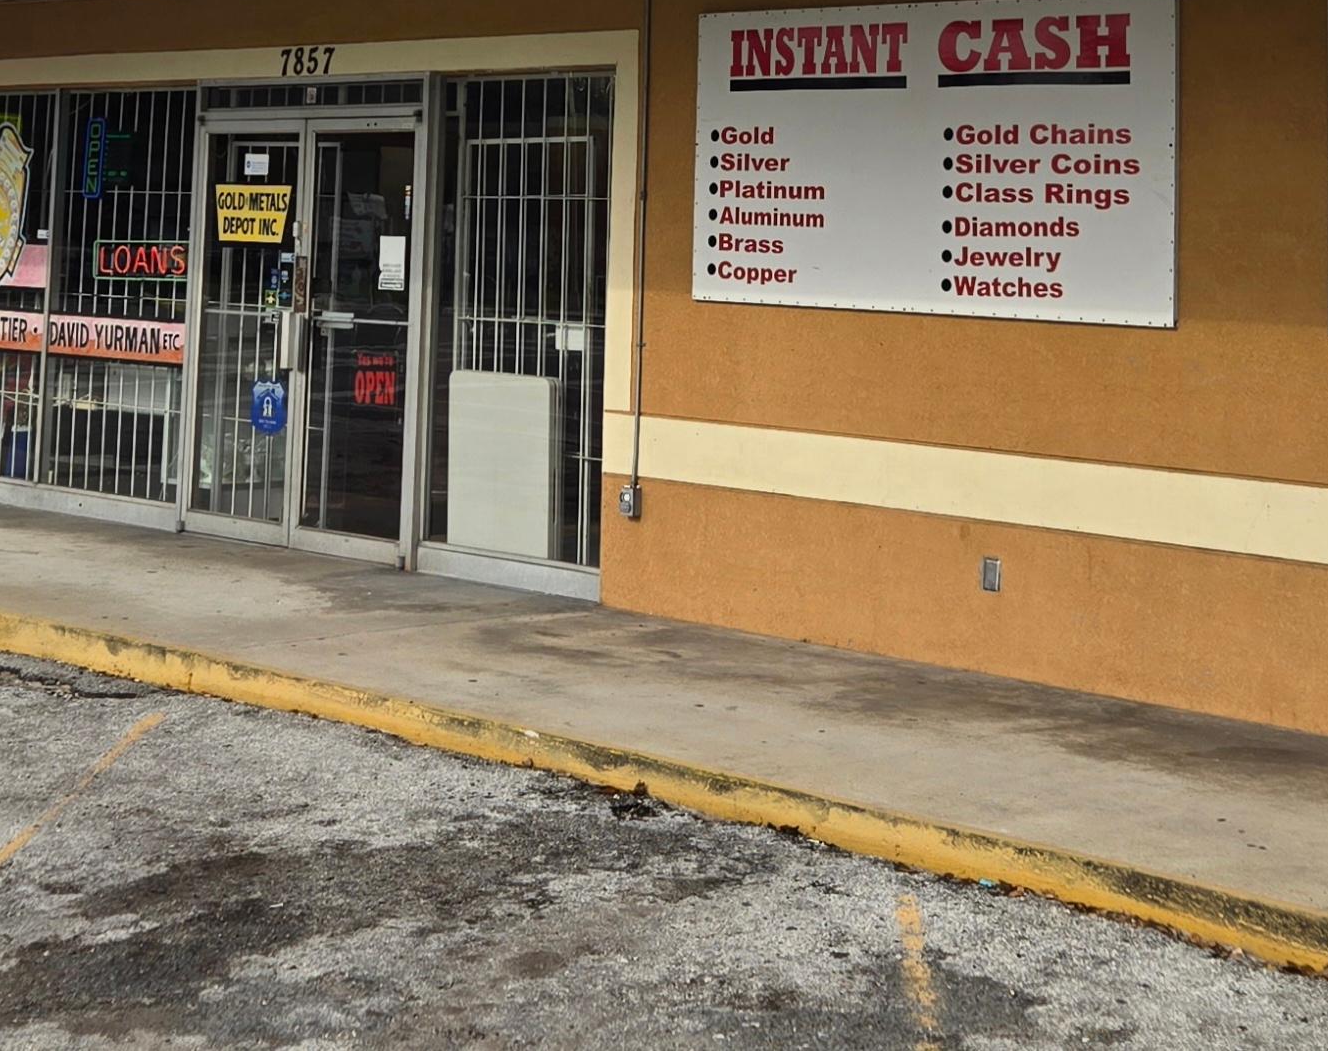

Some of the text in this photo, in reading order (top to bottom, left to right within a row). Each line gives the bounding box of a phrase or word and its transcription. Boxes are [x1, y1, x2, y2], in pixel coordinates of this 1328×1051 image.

[728, 13, 1132, 76] INSTANT CASH
[280, 46, 335, 77] 7857
[720, 127, 776, 146] Gold
[954, 123, 1132, 147] Gold Chains
[86, 123, 102, 193] OPEN
[720, 153, 789, 172] Silver
[955, 152, 1141, 176] Silver Coins
[218, 192, 245, 210] GOLD
[249, 192, 288, 212] METALS
[718, 180, 826, 201] Platinum
[954, 181, 1131, 211] Class Rings
[223, 216, 279, 236] DEPOT INC.
[719, 206, 825, 229] Aluminum
[953, 216, 1081, 239] Diamonds
[717, 233, 784, 255] Brass
[99, 245, 186, 275] LOANS
[954, 245, 1061, 273] Jewelry
[718, 260, 796, 286] Copper
[953, 276, 1064, 300] Watches
[49, 321, 90, 348] DAVID
[94, 323, 162, 354] YURMAN
[163, 333, 180, 351] ETC
[355, 370, 396, 405] OPEN
